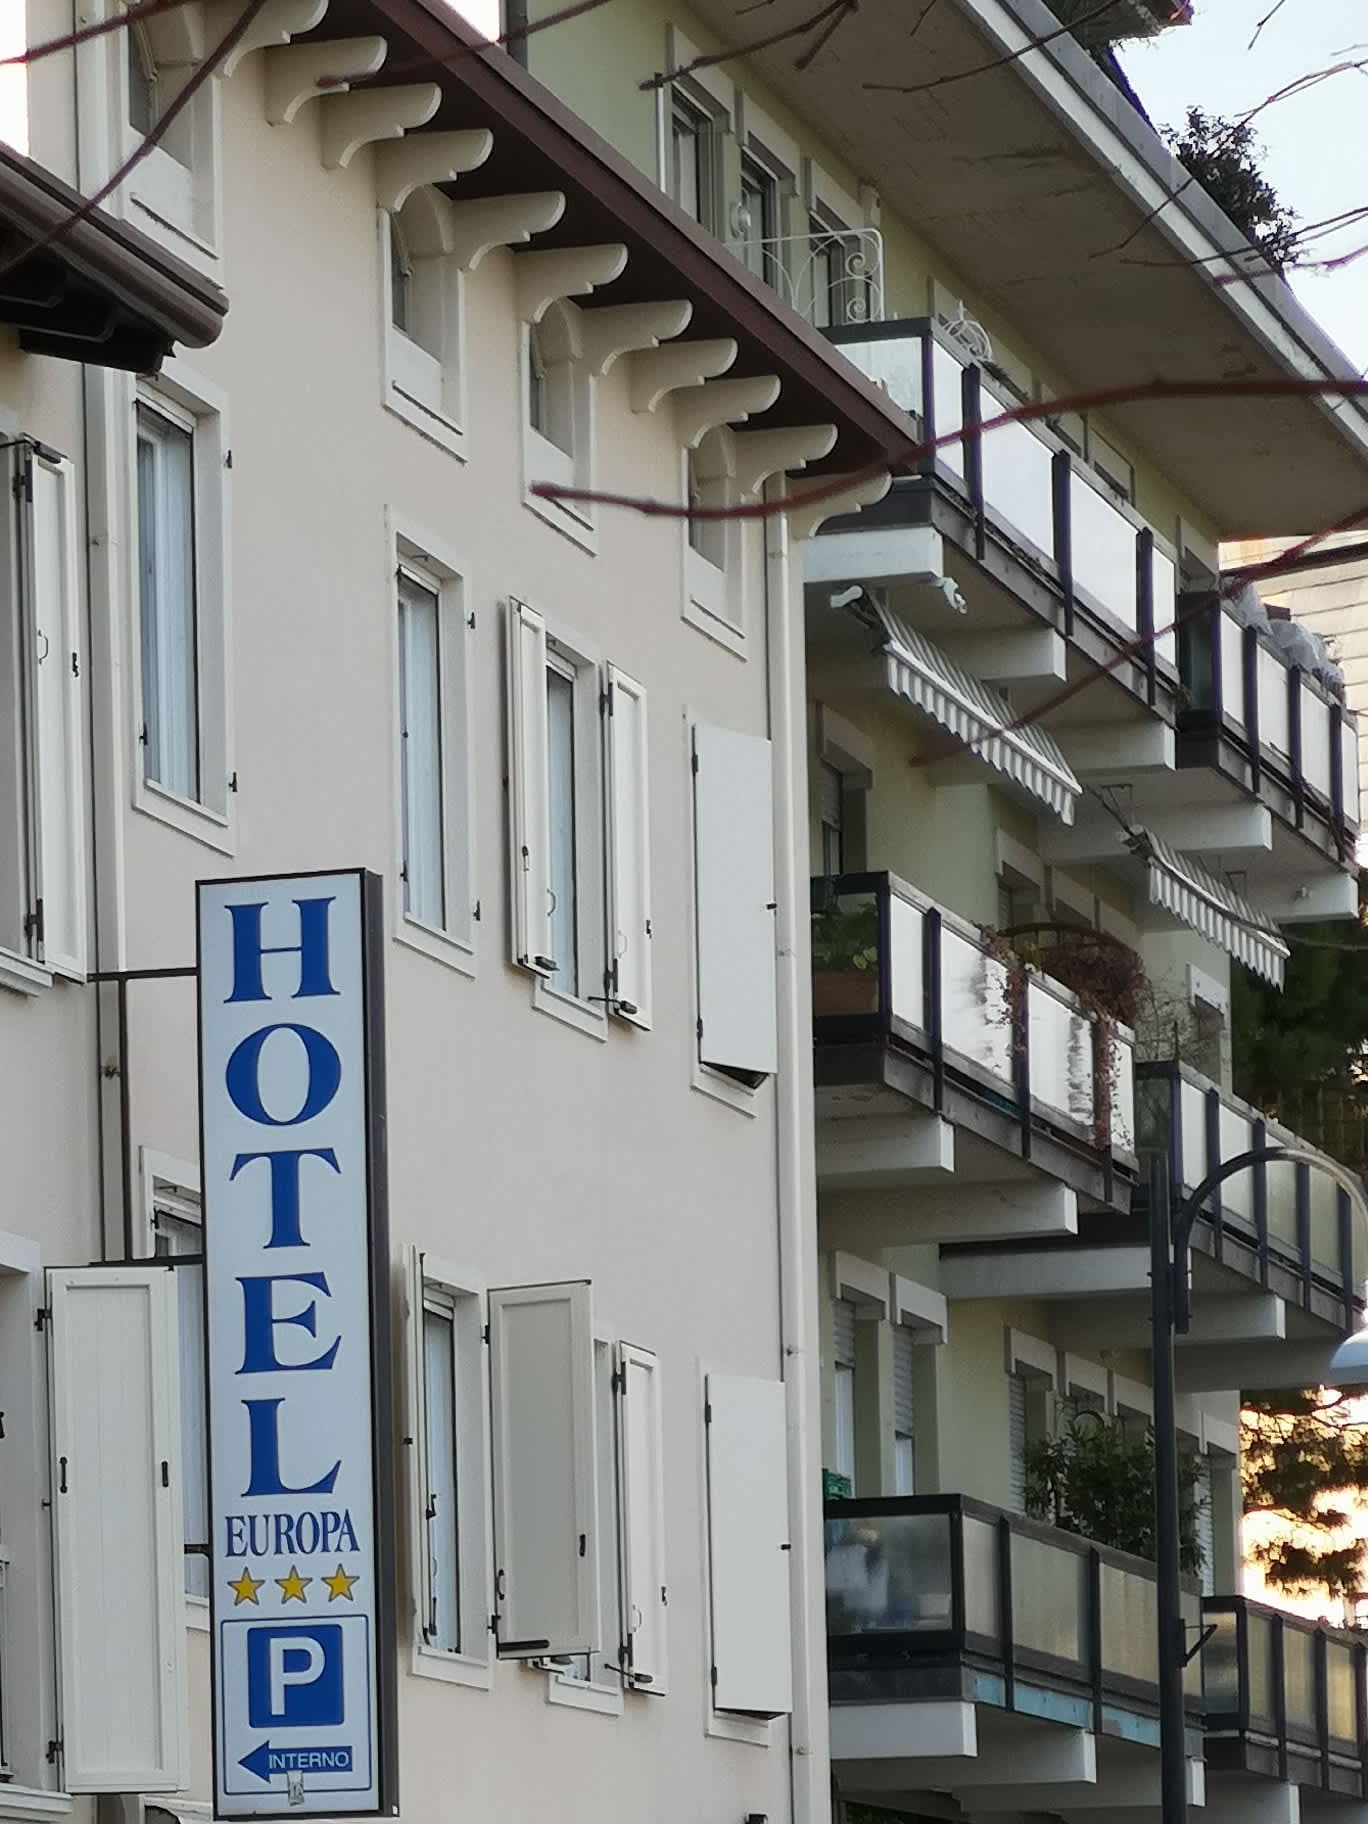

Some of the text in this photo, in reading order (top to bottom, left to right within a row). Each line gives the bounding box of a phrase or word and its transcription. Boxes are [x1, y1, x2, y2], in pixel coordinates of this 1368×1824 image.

[223, 894, 343, 1498] HOTEL
[224, 1508, 360, 1558] EUROPA
[269, 1635, 326, 1716] P
[268, 1750, 350, 1770] INTERNO
